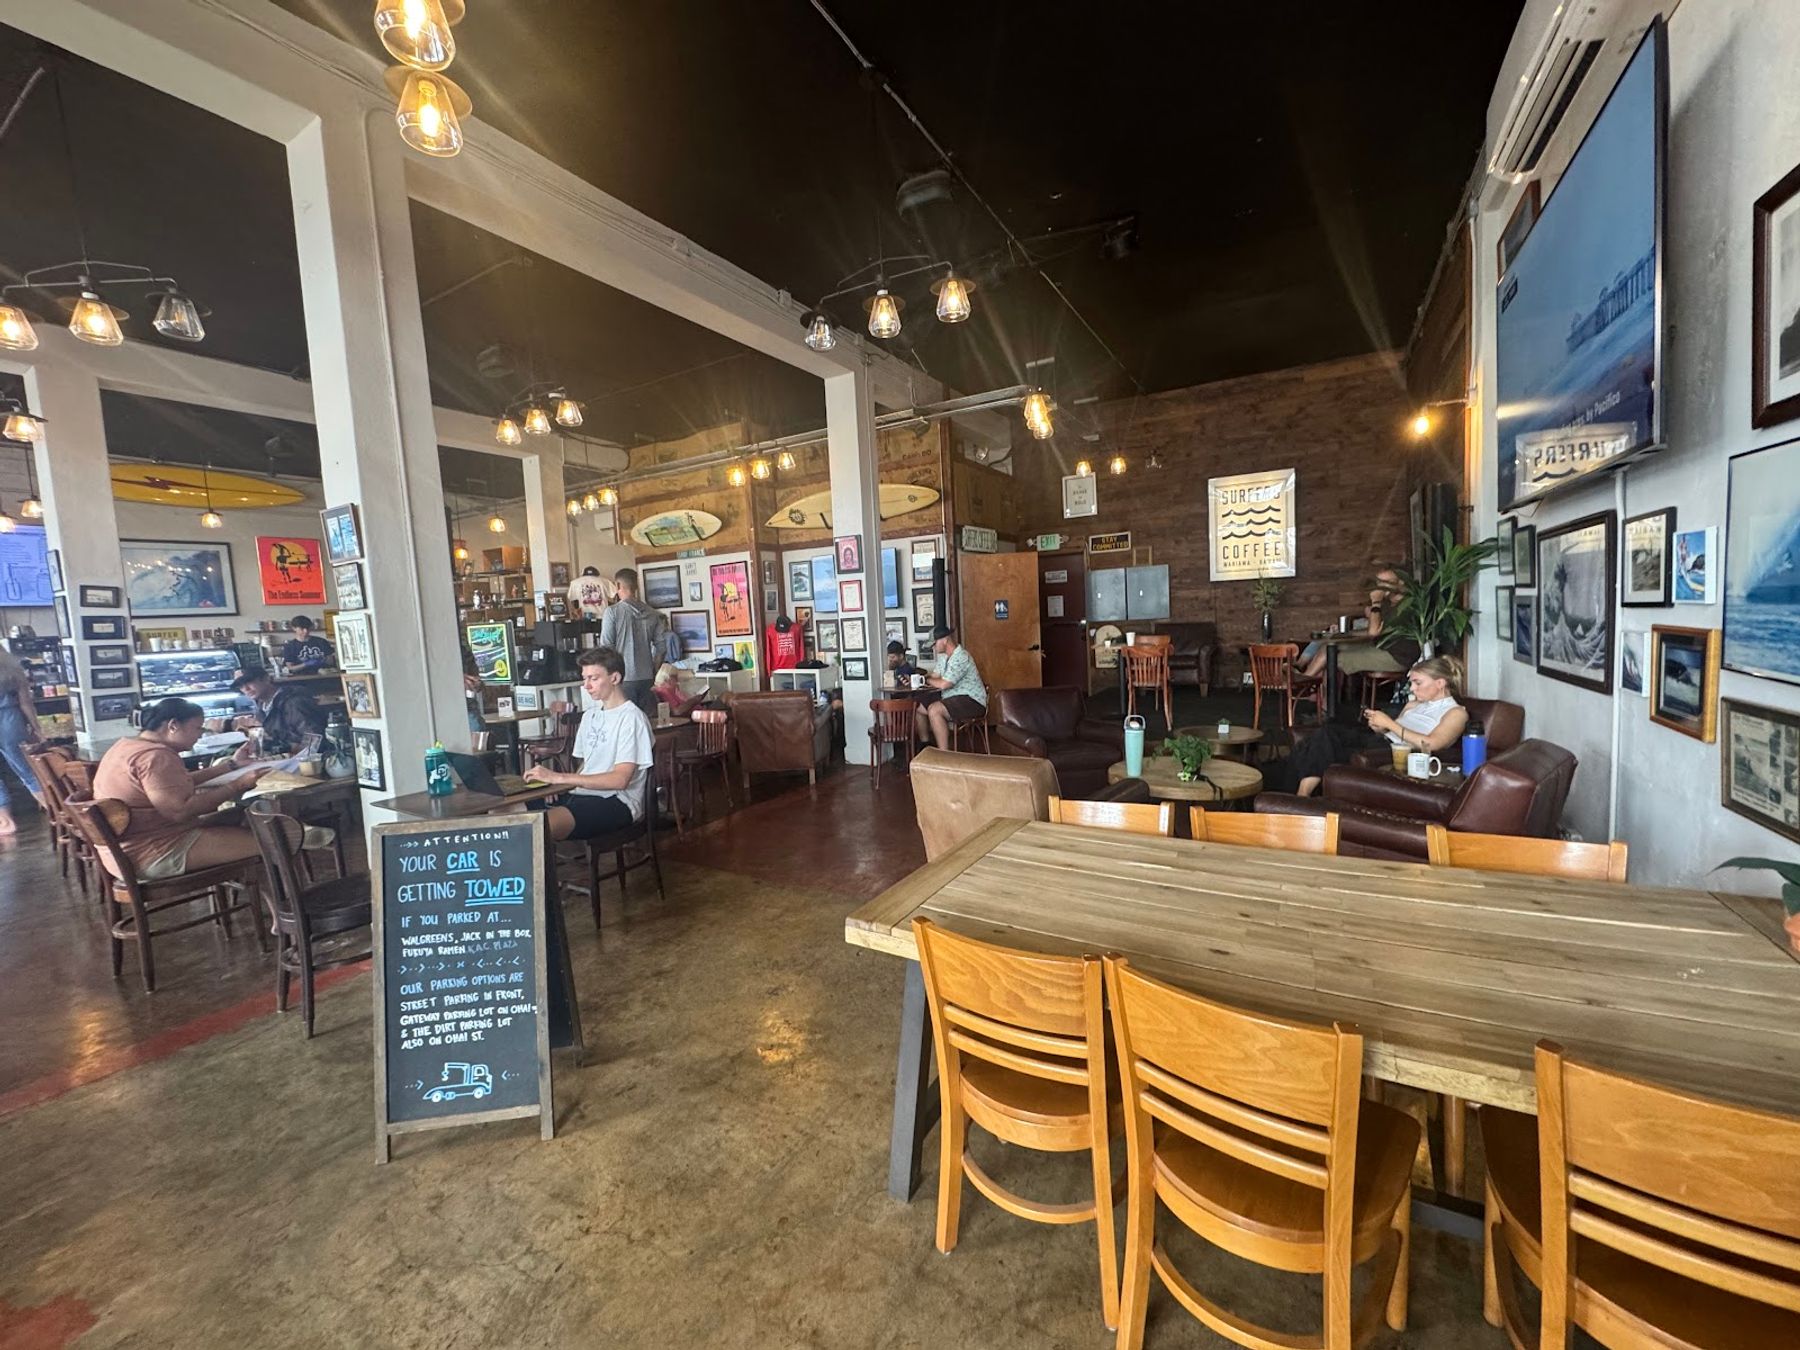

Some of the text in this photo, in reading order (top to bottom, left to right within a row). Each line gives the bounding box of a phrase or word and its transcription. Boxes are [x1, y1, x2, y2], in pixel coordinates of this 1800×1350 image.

[1040, 535, 1056, 549] EXIT
[1101, 536, 1118, 544] STAY
[1222, 541, 1281, 560] COFFEE
[400, 850, 501, 872] YOUR CAR IS
[398, 877, 525, 902] GETTING TOWED
[402, 916, 411, 927] IF
[420, 915, 438, 925] YOU
[447, 912, 481, 924] PARKED
[401, 933, 458, 945] WALGREENS,
[460, 932, 481, 941] JACK
[486, 931, 494, 939] IN
[438, 945, 466, 955] RAMEN
[400, 972, 523, 995] OUR PARKING OPTIONS ARE
[400, 997, 437, 1011] STREET
[444, 992, 479, 1006] PARKING
[484, 991, 492, 1000] IN
[400, 1012, 440, 1025] GATEWAY
[443, 1009, 477, 1020] PARKING
[479, 1007, 494, 1017] LOT
[498, 1006, 508, 1014] ON
[510, 1003, 531, 1014] OHAI
[401, 1017, 512, 1038] & THE DIRT PARKING LOT
[401, 1039, 424, 1049] ALSO
[429, 1036, 442, 1045] ON
